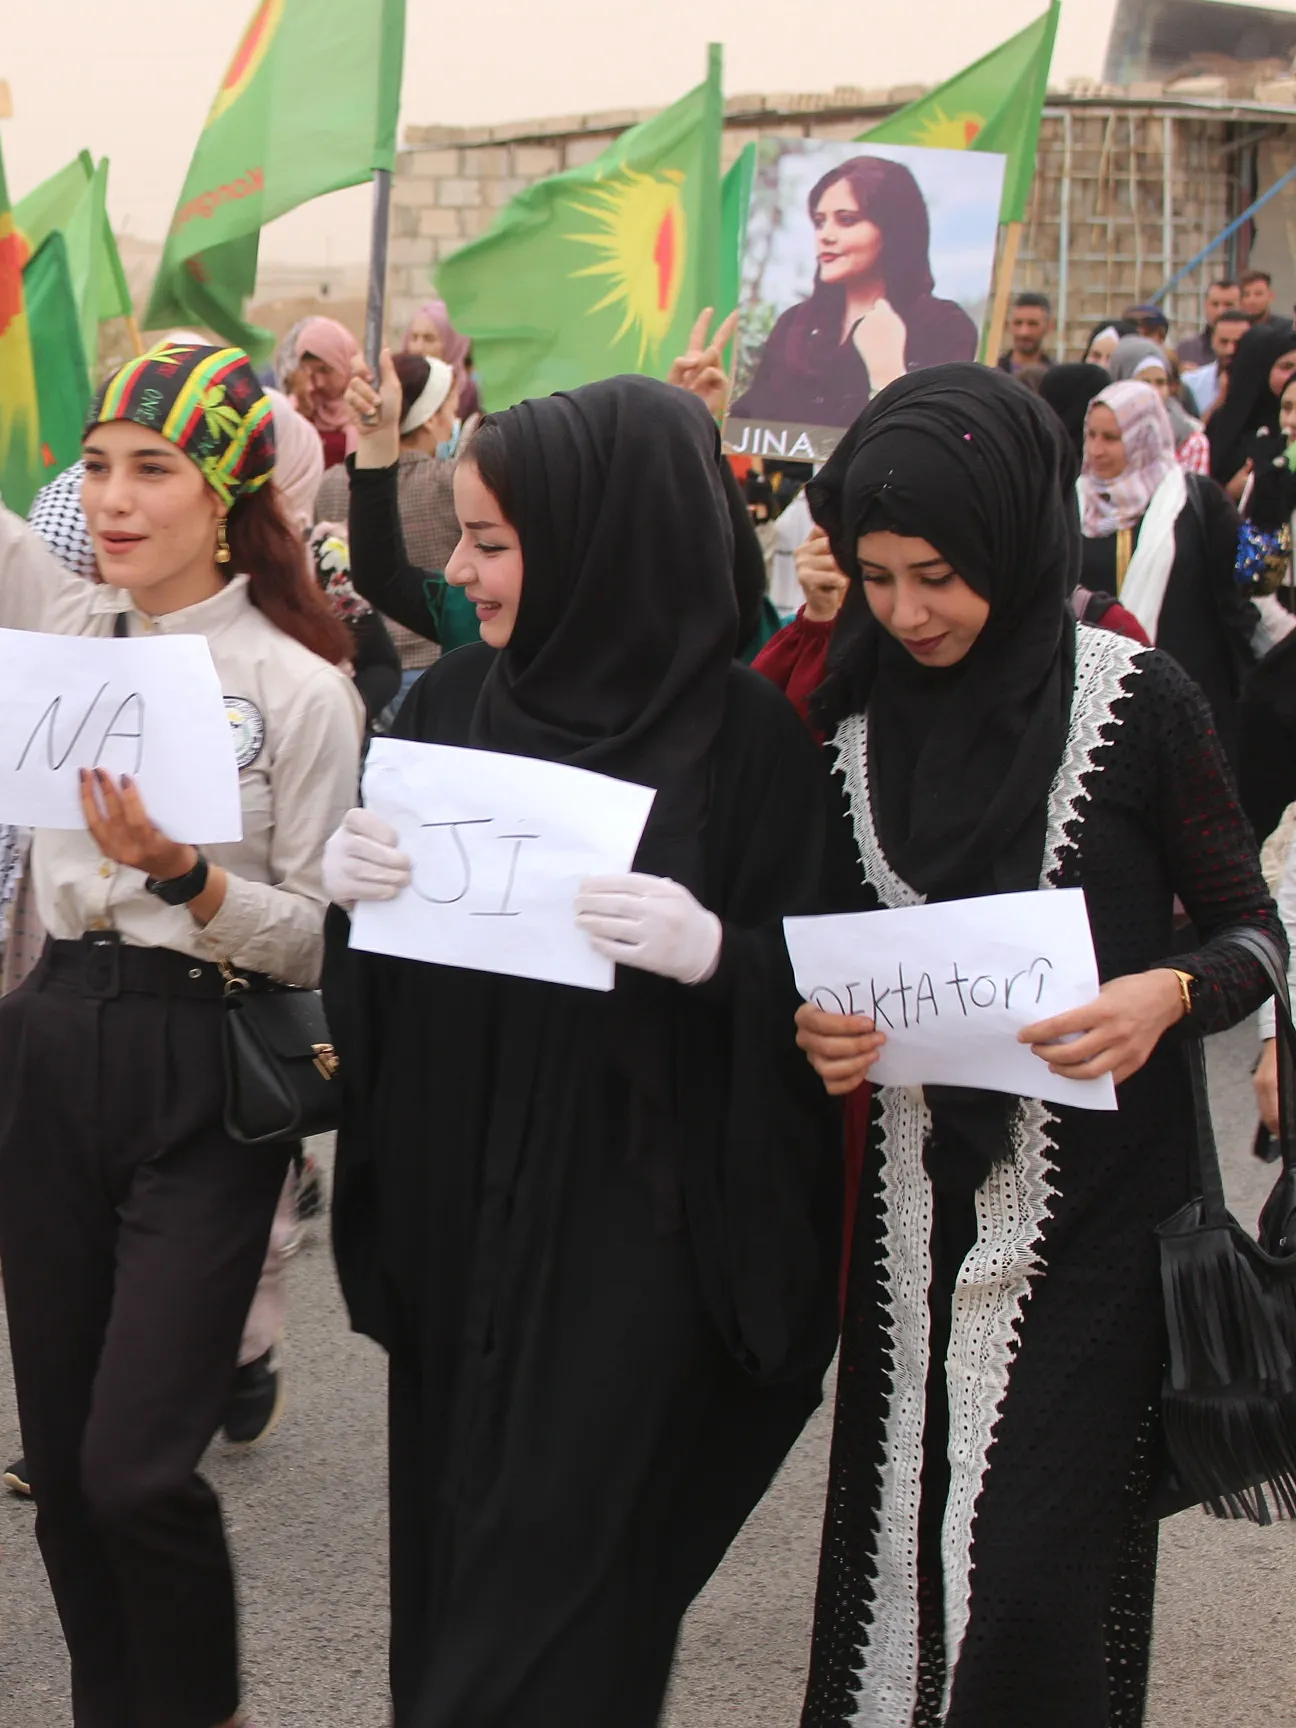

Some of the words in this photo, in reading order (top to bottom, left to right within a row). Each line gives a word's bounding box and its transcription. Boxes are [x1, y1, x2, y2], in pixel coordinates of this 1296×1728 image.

[732, 426, 815, 458] JINA
[14, 680, 145, 775] NA
[411, 817, 542, 916] JI
